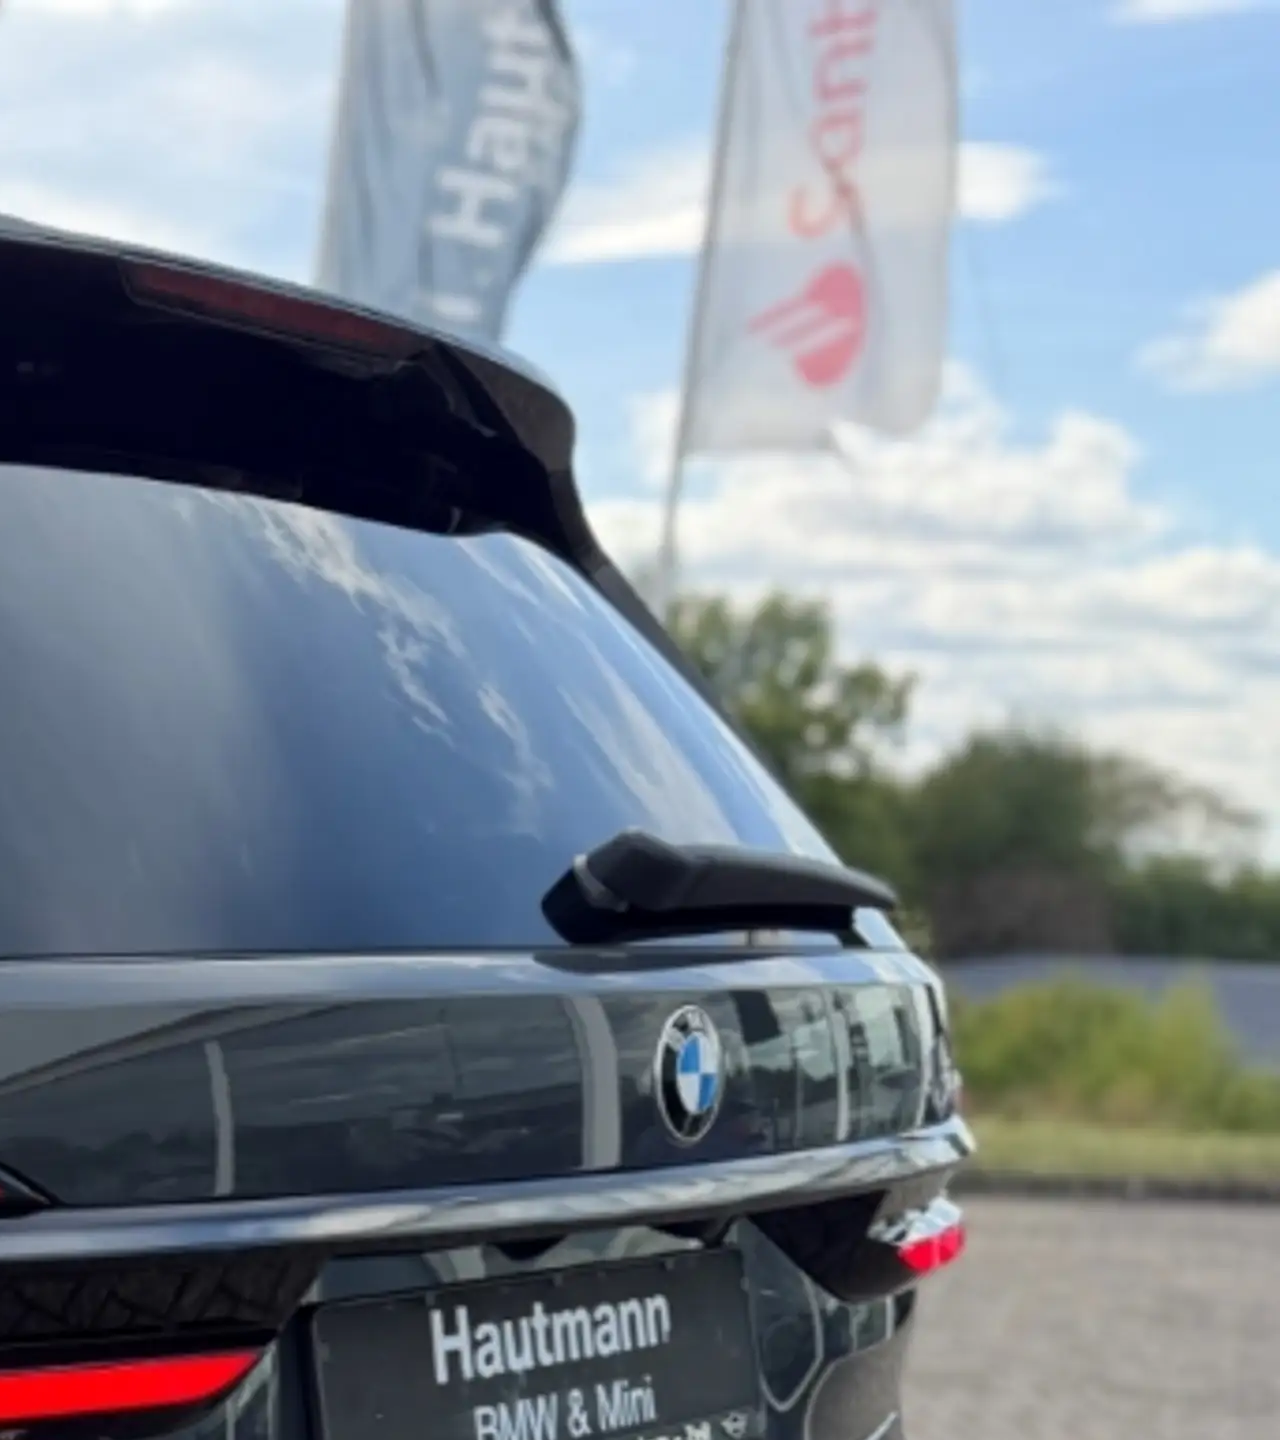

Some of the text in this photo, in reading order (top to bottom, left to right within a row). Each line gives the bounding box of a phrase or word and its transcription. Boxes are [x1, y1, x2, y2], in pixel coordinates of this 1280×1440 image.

[429, 1293, 671, 1385] Hautmann
[566, 1387, 592, 1438] &
[596, 1373, 657, 1432] Mini
